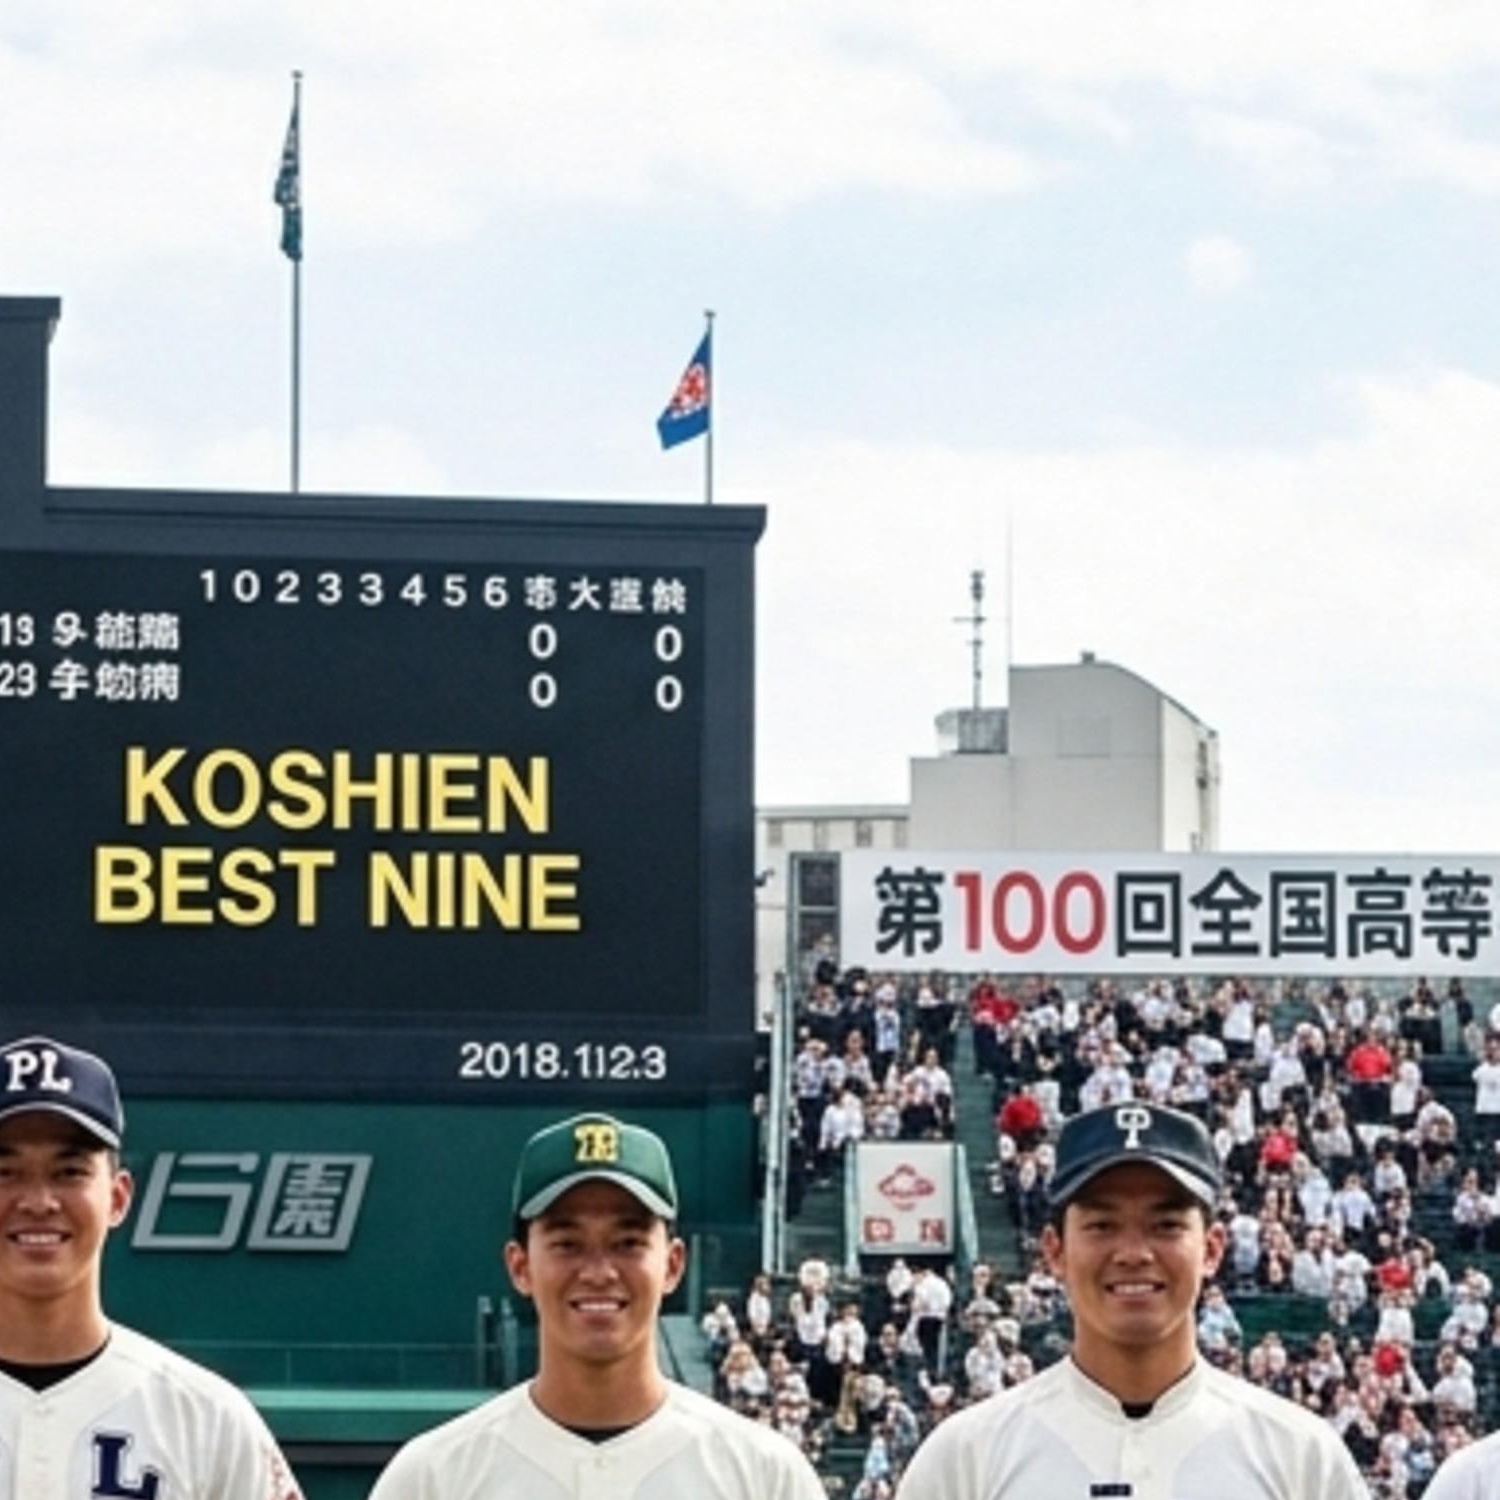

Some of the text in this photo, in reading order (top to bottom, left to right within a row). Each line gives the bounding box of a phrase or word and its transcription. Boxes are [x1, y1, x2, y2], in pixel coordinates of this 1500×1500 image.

[126, 748, 548, 833] KOSHIEN
[95, 847, 580, 930] BEST NINE
[5, 1050, 72, 1093] PL
